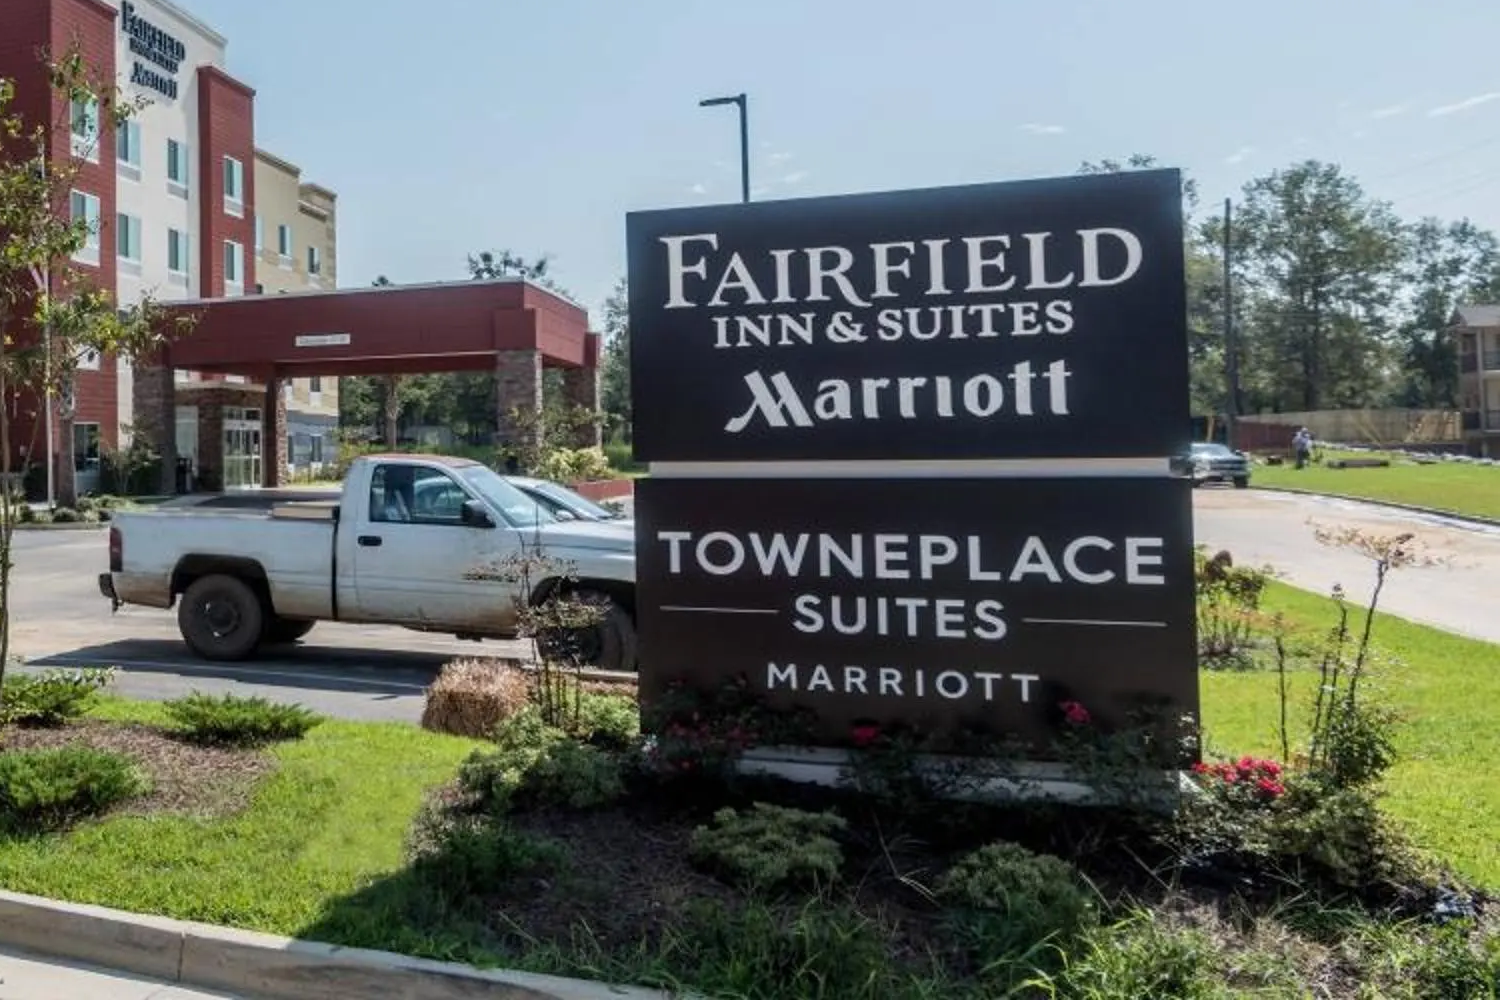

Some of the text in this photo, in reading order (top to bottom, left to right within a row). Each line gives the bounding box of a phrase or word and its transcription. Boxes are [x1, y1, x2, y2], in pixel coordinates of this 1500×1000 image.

[658, 226, 1143, 309] FAIRFIELD
[712, 299, 1074, 349] INN & SUITES
[723, 358, 1073, 433] Marriott
[656, 530, 1167, 586] TOWNEPLACE
[792, 593, 1008, 640] SUITES
[766, 661, 1040, 703] MARRIOTT
